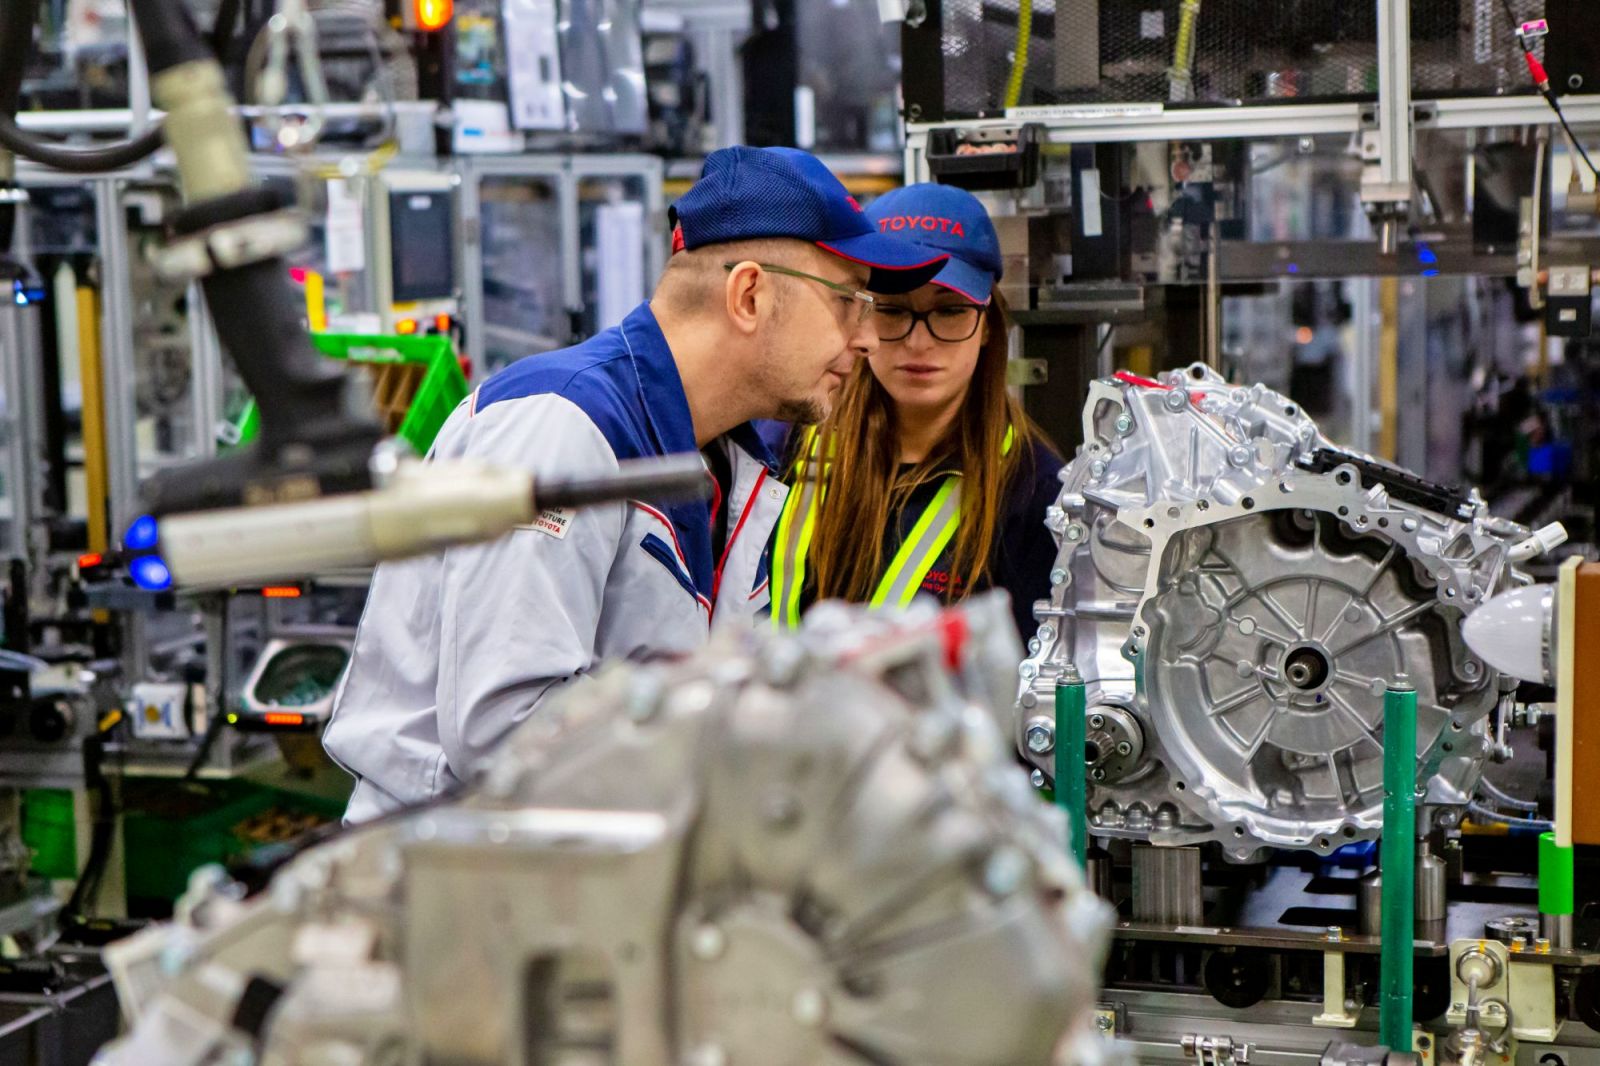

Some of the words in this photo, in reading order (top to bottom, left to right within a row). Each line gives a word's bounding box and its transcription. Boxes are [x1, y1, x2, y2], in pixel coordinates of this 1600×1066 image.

[878, 216, 965, 238] TOYOTA
[534, 518, 561, 533] TOYOTA
[542, 511, 567, 526] UTURE
